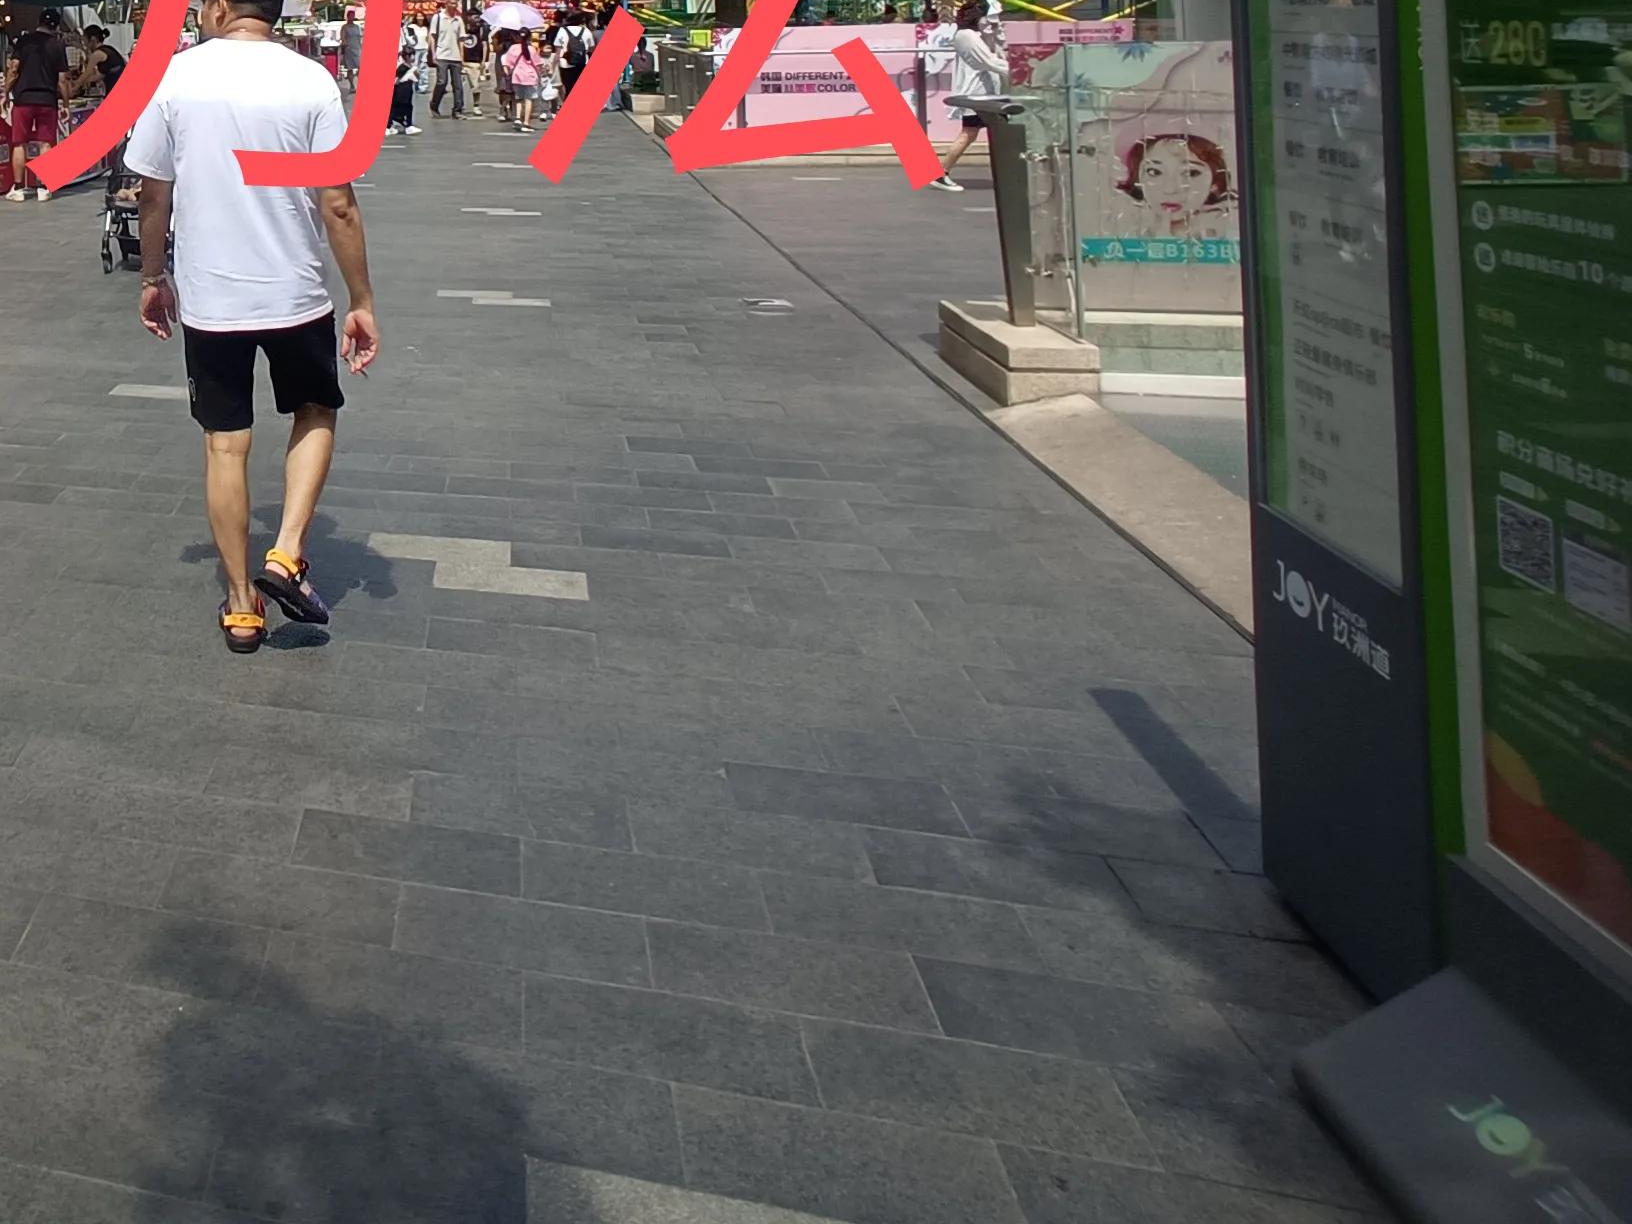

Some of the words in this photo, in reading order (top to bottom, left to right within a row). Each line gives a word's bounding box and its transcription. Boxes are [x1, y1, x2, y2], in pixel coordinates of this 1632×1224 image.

[784, 71, 844, 81] DIFFERENT
[817, 83, 856, 93] COLOR
[1272, 559, 1330, 632] JOY
